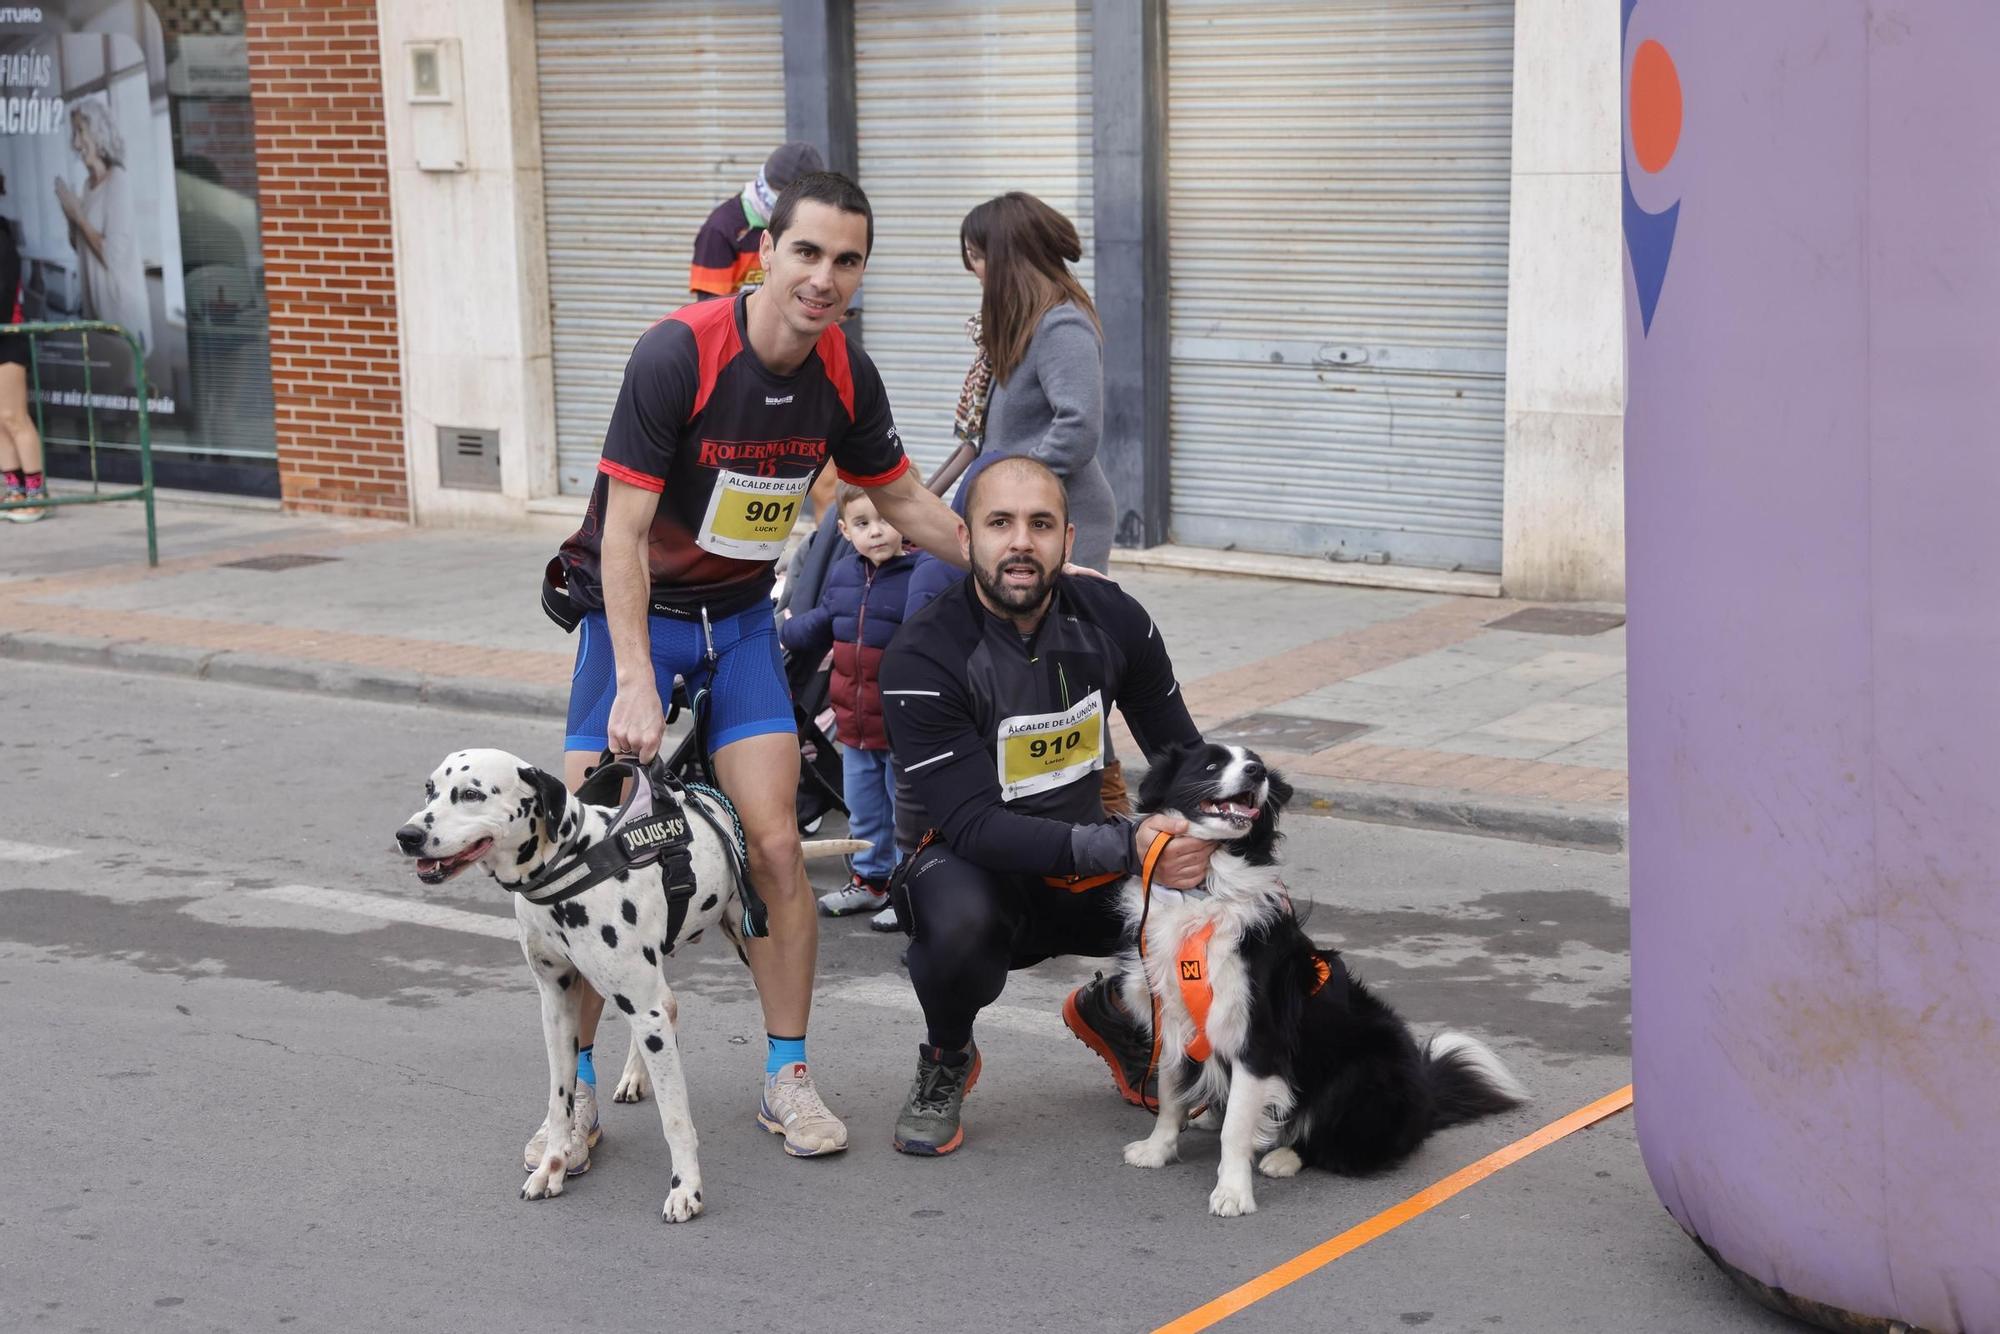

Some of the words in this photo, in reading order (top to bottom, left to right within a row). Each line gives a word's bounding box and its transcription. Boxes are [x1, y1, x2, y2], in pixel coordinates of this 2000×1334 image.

[728, 477, 771, 490] ALCALDE
[772, 482, 784, 491] DE
[786, 483, 796, 491] LA
[745, 501, 795, 522] 901
[1008, 722, 1050, 734] ALCALDE
[1052, 719, 1064, 728] DE
[1066, 715, 1075, 724] LA
[1030, 731, 1080, 758] 910
[623, 818, 685, 851] JULIUS-K9
